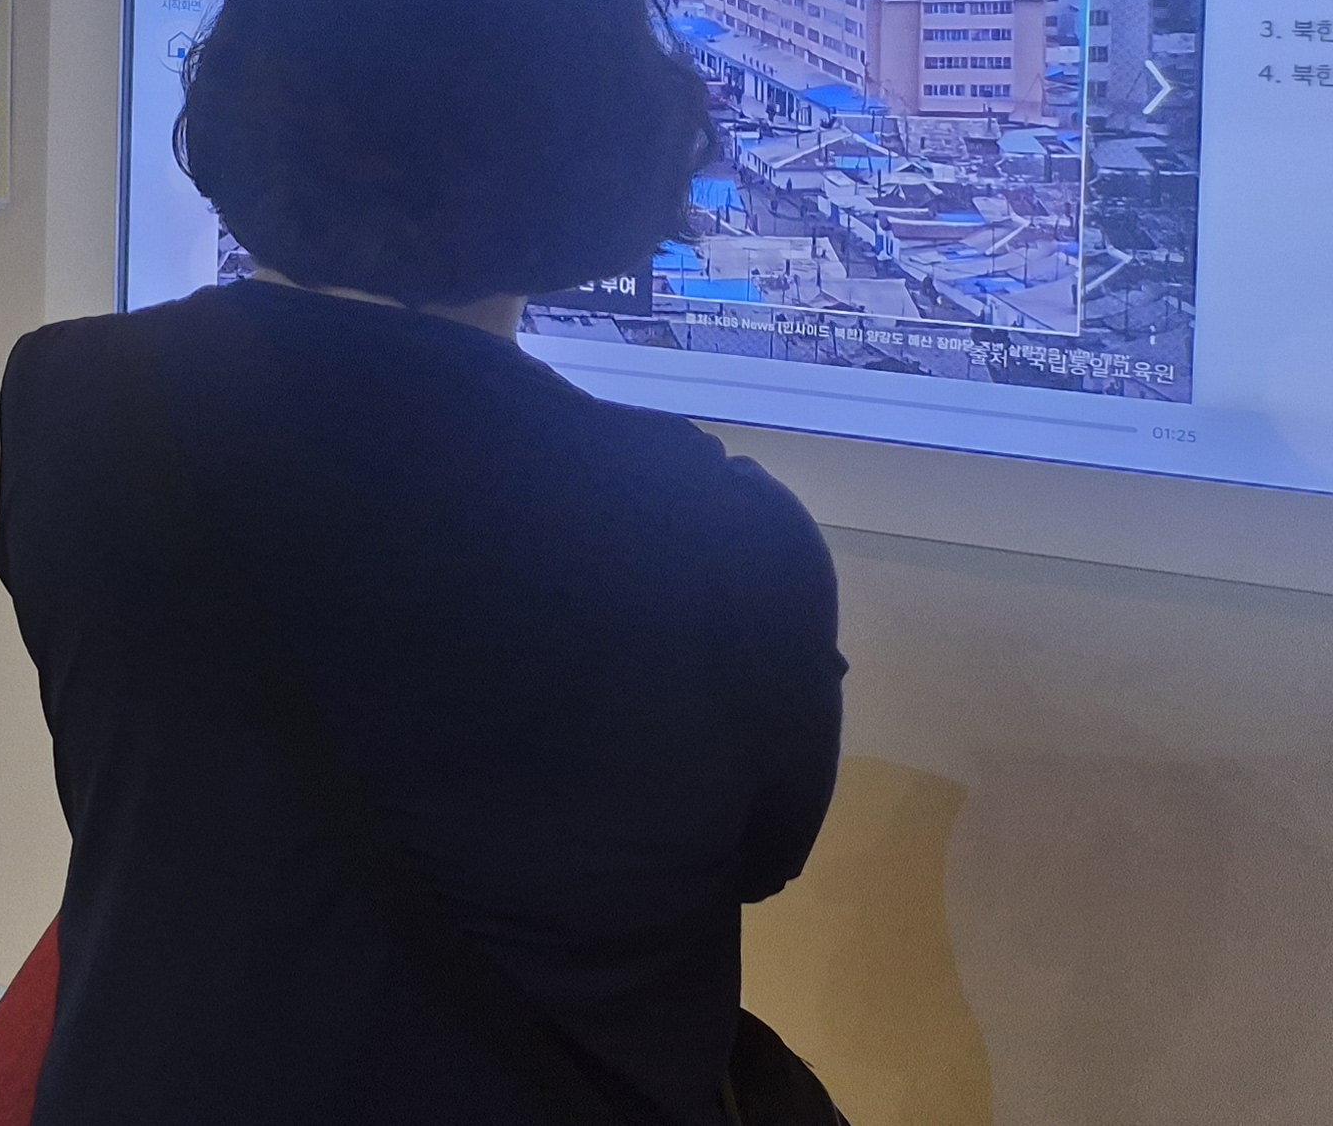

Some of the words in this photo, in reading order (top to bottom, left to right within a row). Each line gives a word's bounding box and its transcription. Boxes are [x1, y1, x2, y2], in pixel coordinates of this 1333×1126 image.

[1259, 20, 1282, 40] 3.
[1257, 64, 1282, 84] 4.
[715, 315, 738, 329] KBS
[777, 320, 830, 338] [인사이드
[969, 344, 1008, 368] 출처
[1152, 426, 1197, 443] 01:25
